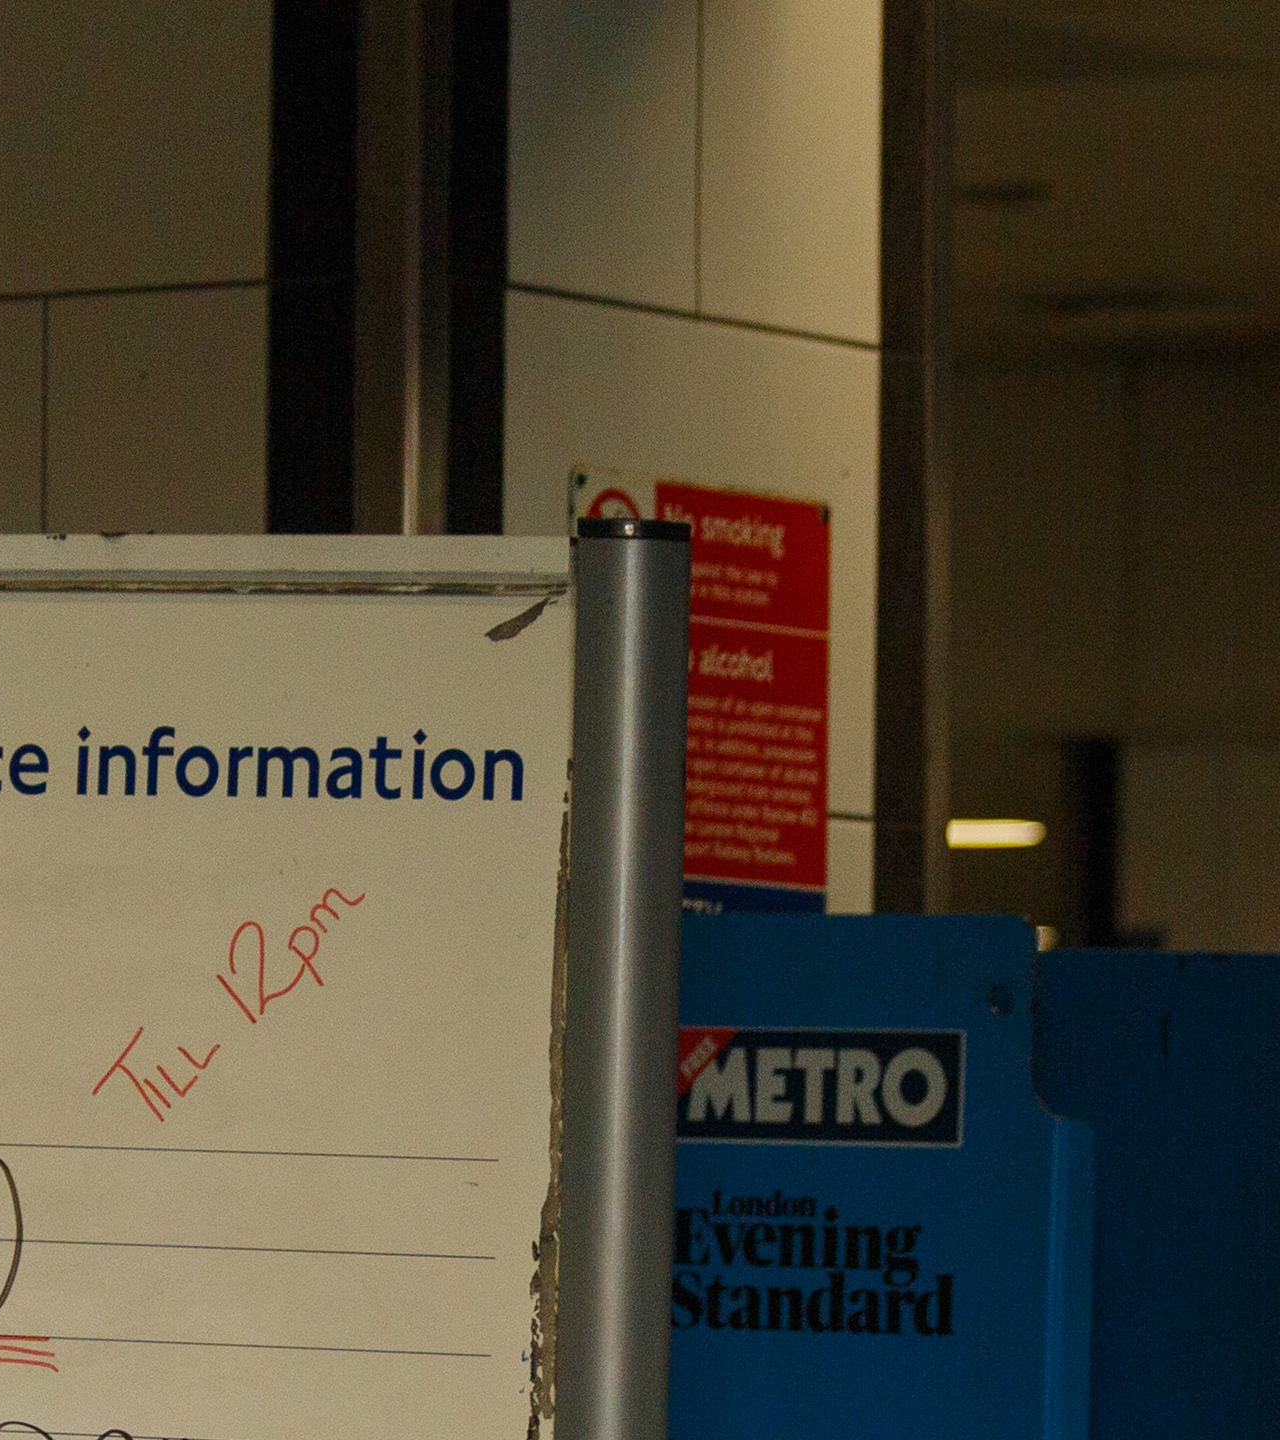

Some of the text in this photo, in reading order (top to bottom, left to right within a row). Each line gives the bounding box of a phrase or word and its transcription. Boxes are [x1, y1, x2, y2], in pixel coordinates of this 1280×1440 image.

[700, 513, 786, 561] smoking
[699, 643, 774, 682] alcohol
[76, 726, 524, 801] information
[92, 888, 366, 1122] TILL 12pm
[687, 1046, 947, 1127] METRO
[712, 1190, 817, 1217] London
[674, 1207, 923, 1287] Evening
[671, 1270, 954, 1337] Standard
